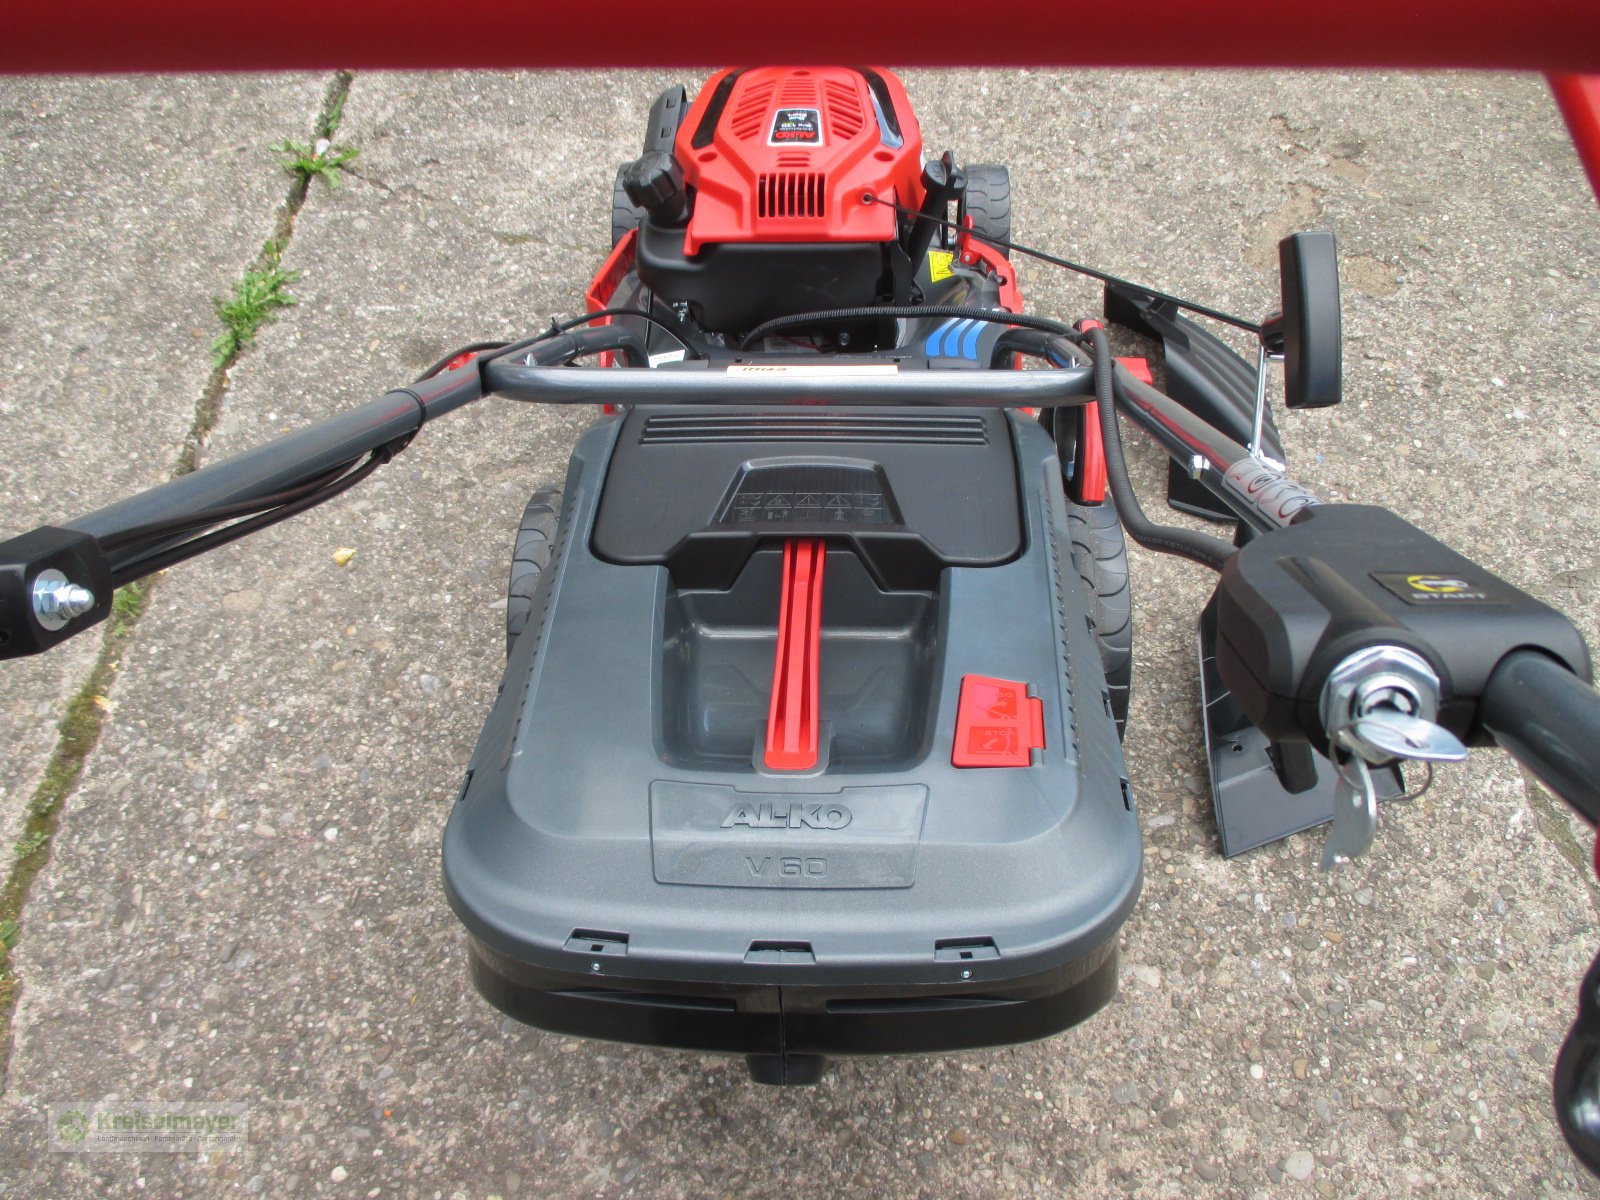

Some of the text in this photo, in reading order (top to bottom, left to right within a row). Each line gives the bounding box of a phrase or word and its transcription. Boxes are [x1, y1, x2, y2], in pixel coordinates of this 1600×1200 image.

[719, 803, 853, 830] AL-KO
[745, 856, 829, 878] V 60
